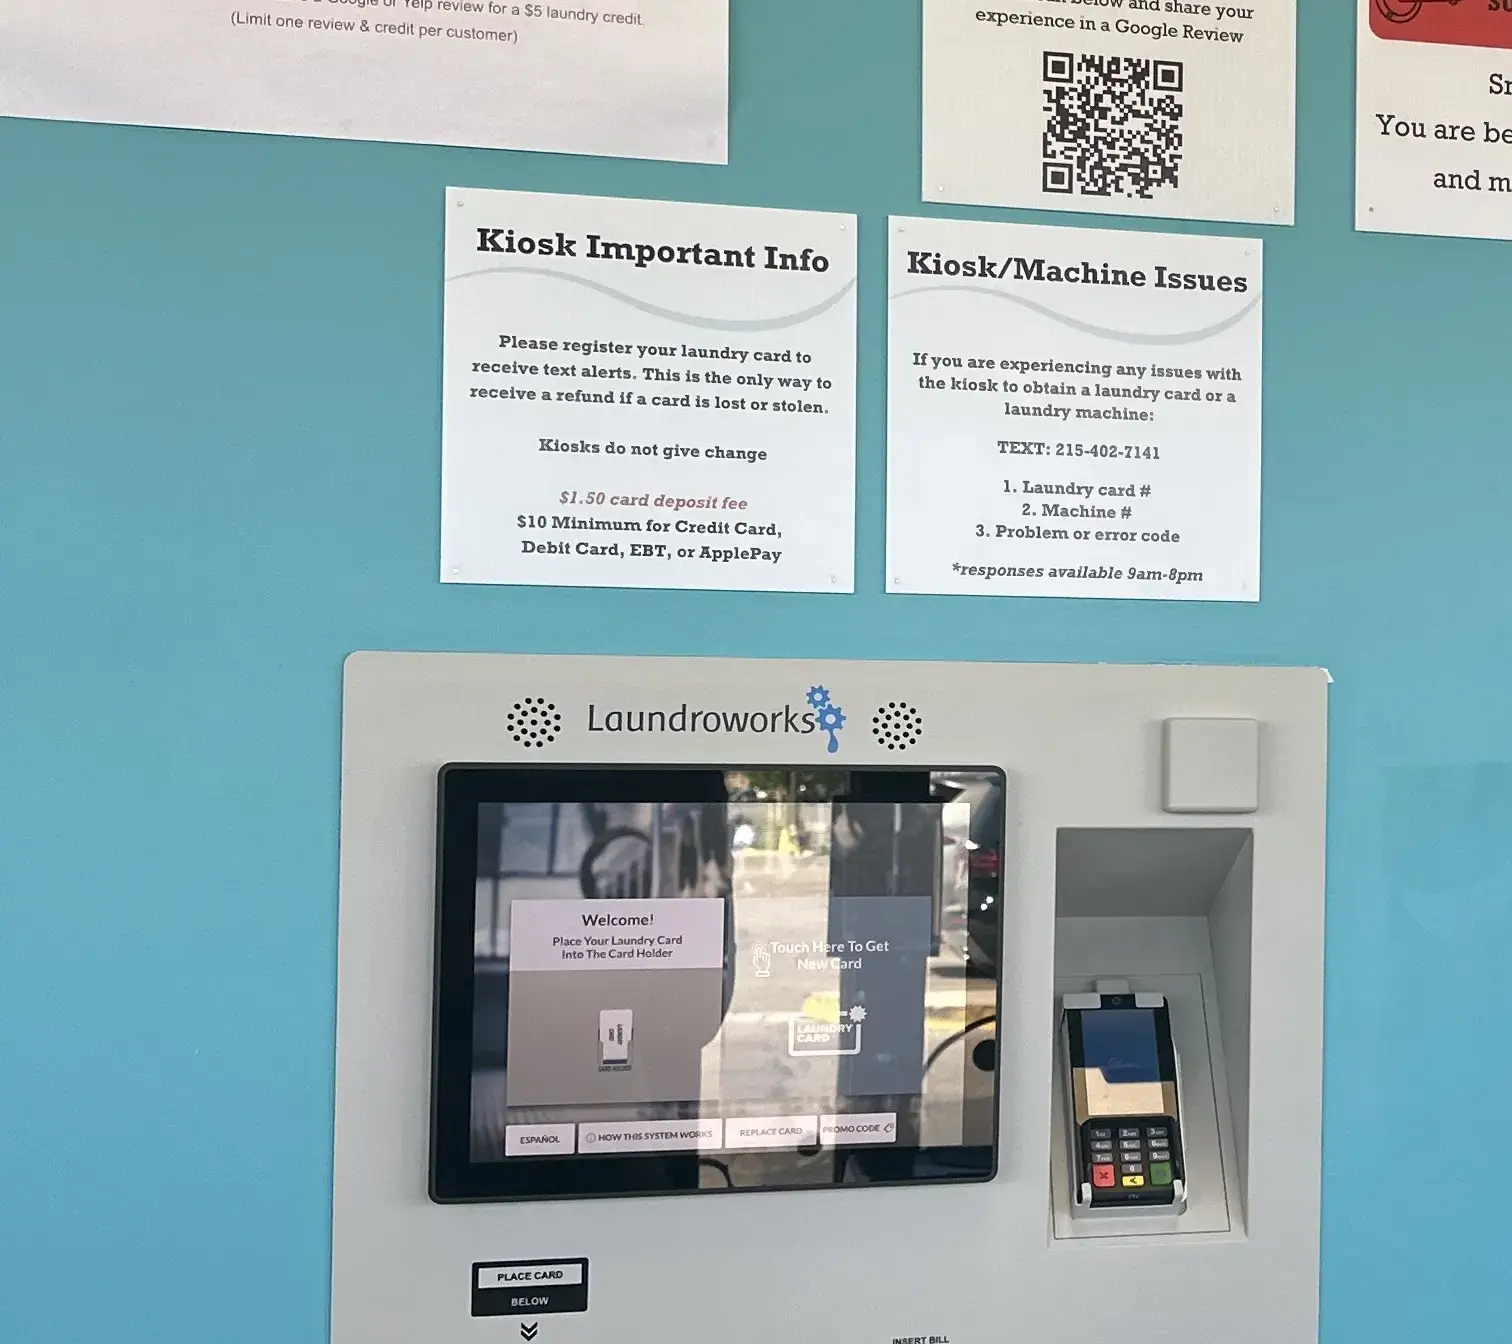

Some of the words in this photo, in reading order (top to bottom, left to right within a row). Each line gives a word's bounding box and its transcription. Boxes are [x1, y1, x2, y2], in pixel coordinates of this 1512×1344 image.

[1214, 6, 1255, 21] your
[230, 10, 272, 27] (Limit
[275, 17, 304, 29] one
[308, 18, 356, 32] review
[374, 21, 415, 36] credit
[418, 25, 444, 39] per
[446, 27, 518, 45] customer)
[975, 10, 1076, 29] experience
[1079, 15, 1097, 31] in
[1100, 21, 1111, 32] a
[1115, 18, 1179, 40] Google
[1182, 24, 1245, 44] Review
[1375, 113, 1427, 139] You
[1433, 123, 1476, 142] are
[1433, 169, 1482, 191] and
[476, 227, 577, 258] Kiosk
[585, 234, 756, 269] Important
[763, 245, 830, 273] Info
[907, 250, 1147, 287] Kiosk/Machine
[1154, 265, 1248, 293] Issues
[498, 334, 559, 351] Please
[562, 339, 634, 356] register
[636, 345, 678, 359] your
[680, 344, 750, 364] laundry
[753, 349, 792, 363] card
[795, 351, 812, 364] to
[538, 438, 601, 454] Kiosks
[604, 441, 627, 455] do
[630, 444, 659, 457] not
[662, 443, 700, 460] give
[704, 445, 768, 464] change
[997, 440, 1051, 456] TEXT:
[1055, 442, 1160, 460] 215-402-7141
[559, 490, 606, 506] $1.50
[609, 493, 650, 507] card
[653, 493, 718, 512] deposit
[721, 496, 748, 511] fee
[975, 523, 991, 538] 3.
[995, 524, 1070, 540] Problem
[1072, 530, 1091, 541] or
[1094, 530, 1138, 542] error
[1140, 529, 1181, 543] code
[1047, 565, 1123, 580] available
[1126, 566, 1203, 585] 9am-8pm
[588, 703, 815, 734] Laundroworks
[581, 913, 654, 927] Welcome!
[553, 937, 582, 947] Place
[584, 936, 610, 947] Your
[612, 936, 655, 946] Laundry
[657, 935, 683, 945] Card
[497, 1271, 532, 1282] PLACE
[533, 1270, 564, 1281] CARD
[511, 1296, 549, 1307] BELOW
